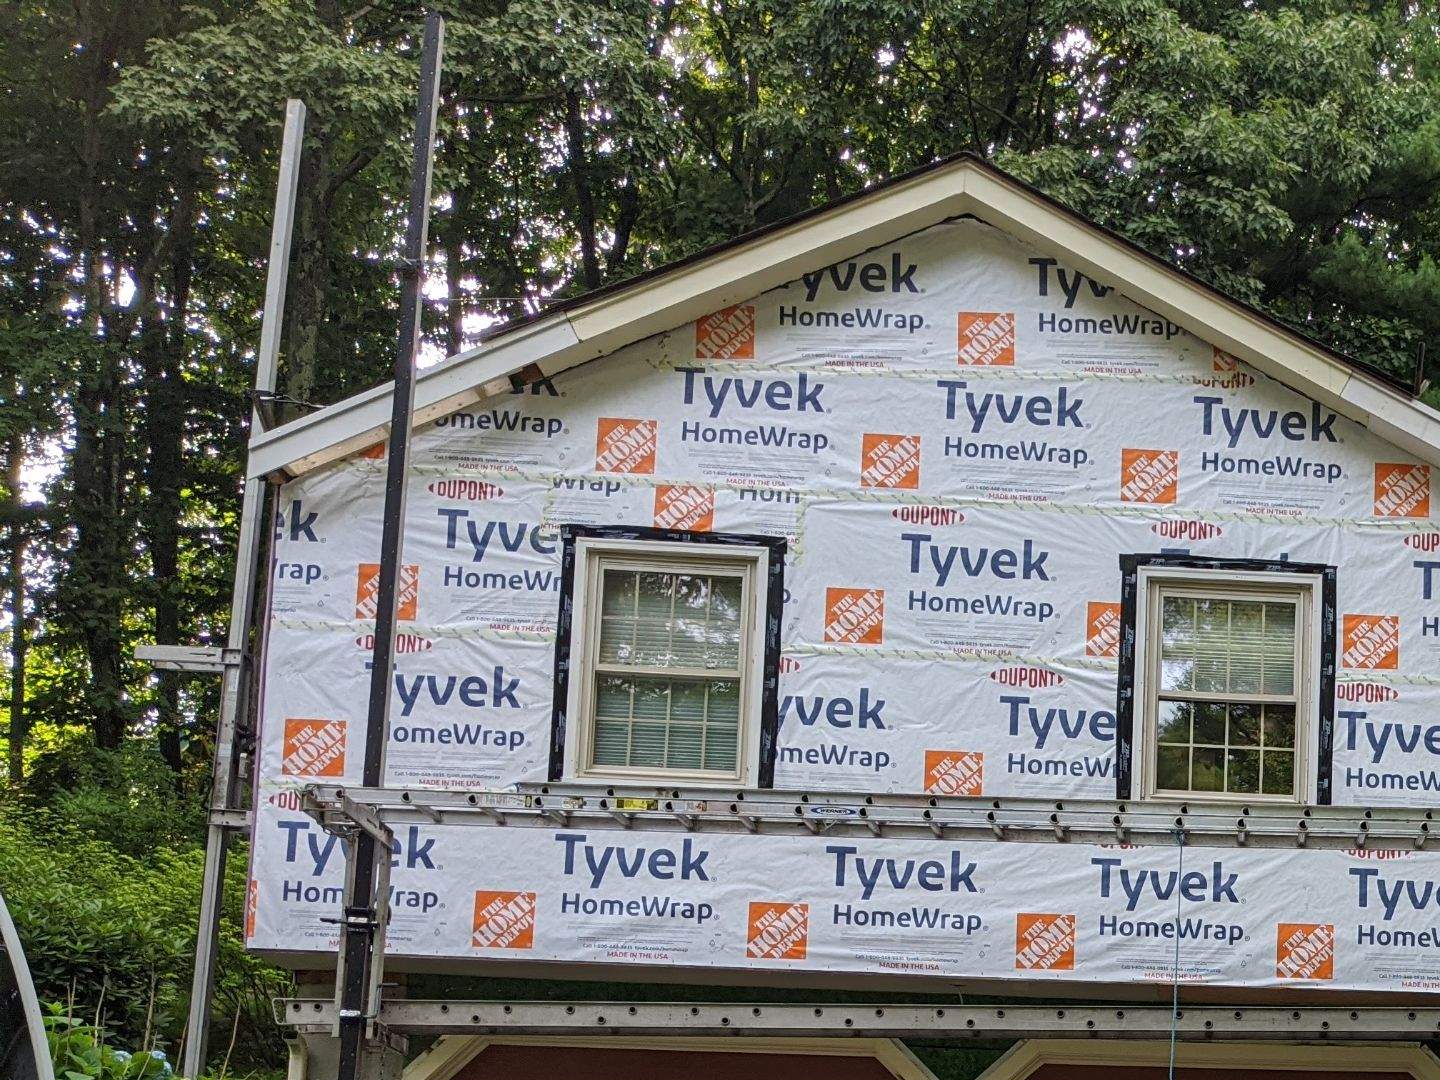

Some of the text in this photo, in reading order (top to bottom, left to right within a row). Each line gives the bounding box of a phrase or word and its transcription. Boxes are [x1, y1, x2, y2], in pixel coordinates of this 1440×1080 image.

[803, 254, 918, 302] yvek
[1029, 258, 1115, 308] Tyv
[695, 306, 755, 357] HOME
[700, 311, 727, 332] THE
[779, 306, 924, 333] HomeWrap
[963, 318, 988, 338] THE
[1038, 313, 1180, 339] HomeWrap
[718, 327, 754, 359] DEPOT
[958, 313, 1014, 363] HOME
[979, 333, 1013, 365] DEPOT
[674, 367, 824, 418] Tyvek
[937, 380, 1084, 433] Tyvek
[436, 410, 563, 437] omeWrap
[602, 424, 629, 446] THE
[681, 421, 828, 454] HomeWrap
[1194, 396, 1338, 448] Tyvek
[597, 419, 657, 472] HOME
[620, 440, 656, 474] DEPOT
[861, 434, 920, 487] HOME
[866, 439, 892, 461] THE
[944, 437, 1088, 468] HomeWrap
[883, 455, 919, 489] DEPOT
[1121, 450, 1178, 502] HOME
[1126, 455, 1151, 476] THE
[1201, 452, 1342, 483] HomeWrap
[1380, 469, 1404, 490] THE
[438, 481, 495, 501] DUPONT
[553, 479, 623, 497] Wrap
[1143, 471, 1177, 504] DEPOT
[1375, 464, 1429, 515] HOME
[1396, 485, 1428, 517] DEPOT
[901, 506, 957, 526] DUPONT
[1160, 520, 1216, 540] DUPONT
[437, 508, 558, 562] Tyve
[901, 534, 1049, 586] Tyvek
[444, 566, 561, 592] HomeWr
[825, 588, 885, 642] HOME
[830, 593, 857, 616] THE
[908, 591, 1054, 622] HomeWrap
[1094, 608, 1114, 630] THE
[848, 610, 884, 644] DEPOT
[1343, 616, 1398, 667] HOME
[1348, 621, 1372, 642] THE
[366, 634, 424, 653] DONT
[1364, 637, 1397, 669] DEPOT
[365, 661, 521, 716] yvek
[1000, 668, 1056, 688] DUPONT
[1337, 683, 1392, 703] DUPONT
[777, 688, 886, 731] yvek
[1000, 696, 1116, 750] Tyve
[282, 720, 346, 774] HOME
[288, 725, 316, 748] THE
[387, 723, 525, 750] omeWrap
[306, 742, 345, 776] DEPOT
[773, 744, 890, 771] omeWrap
[931, 758, 954, 778] THE
[1008, 753, 1116, 778] HomeWr
[555, 834, 709, 888] Tyvek
[825, 846, 977, 900] Tyvek
[283, 880, 439, 913] Homrap
[1091, 858, 1239, 911] Tyvek
[472, 891, 536, 947] HOME
[478, 896, 506, 920] THE
[561, 893, 713, 924] HomeWrap
[753, 908, 780, 930] THE
[834, 904, 982, 935] HomeWrap
[496, 914, 535, 949] DEPOT
[748, 903, 808, 957] HOME
[771, 925, 807, 959] DEPOT
[1017, 914, 1075, 967] HOME
[1022, 919, 1048, 941] THE
[1100, 915, 1244, 945] HomeWrap
[1282, 930, 1307, 952] THE
[1039, 935, 1074, 969] DEPOT
[1277, 925, 1334, 977] HOME
[1299, 946, 1333, 979] DEPOT
